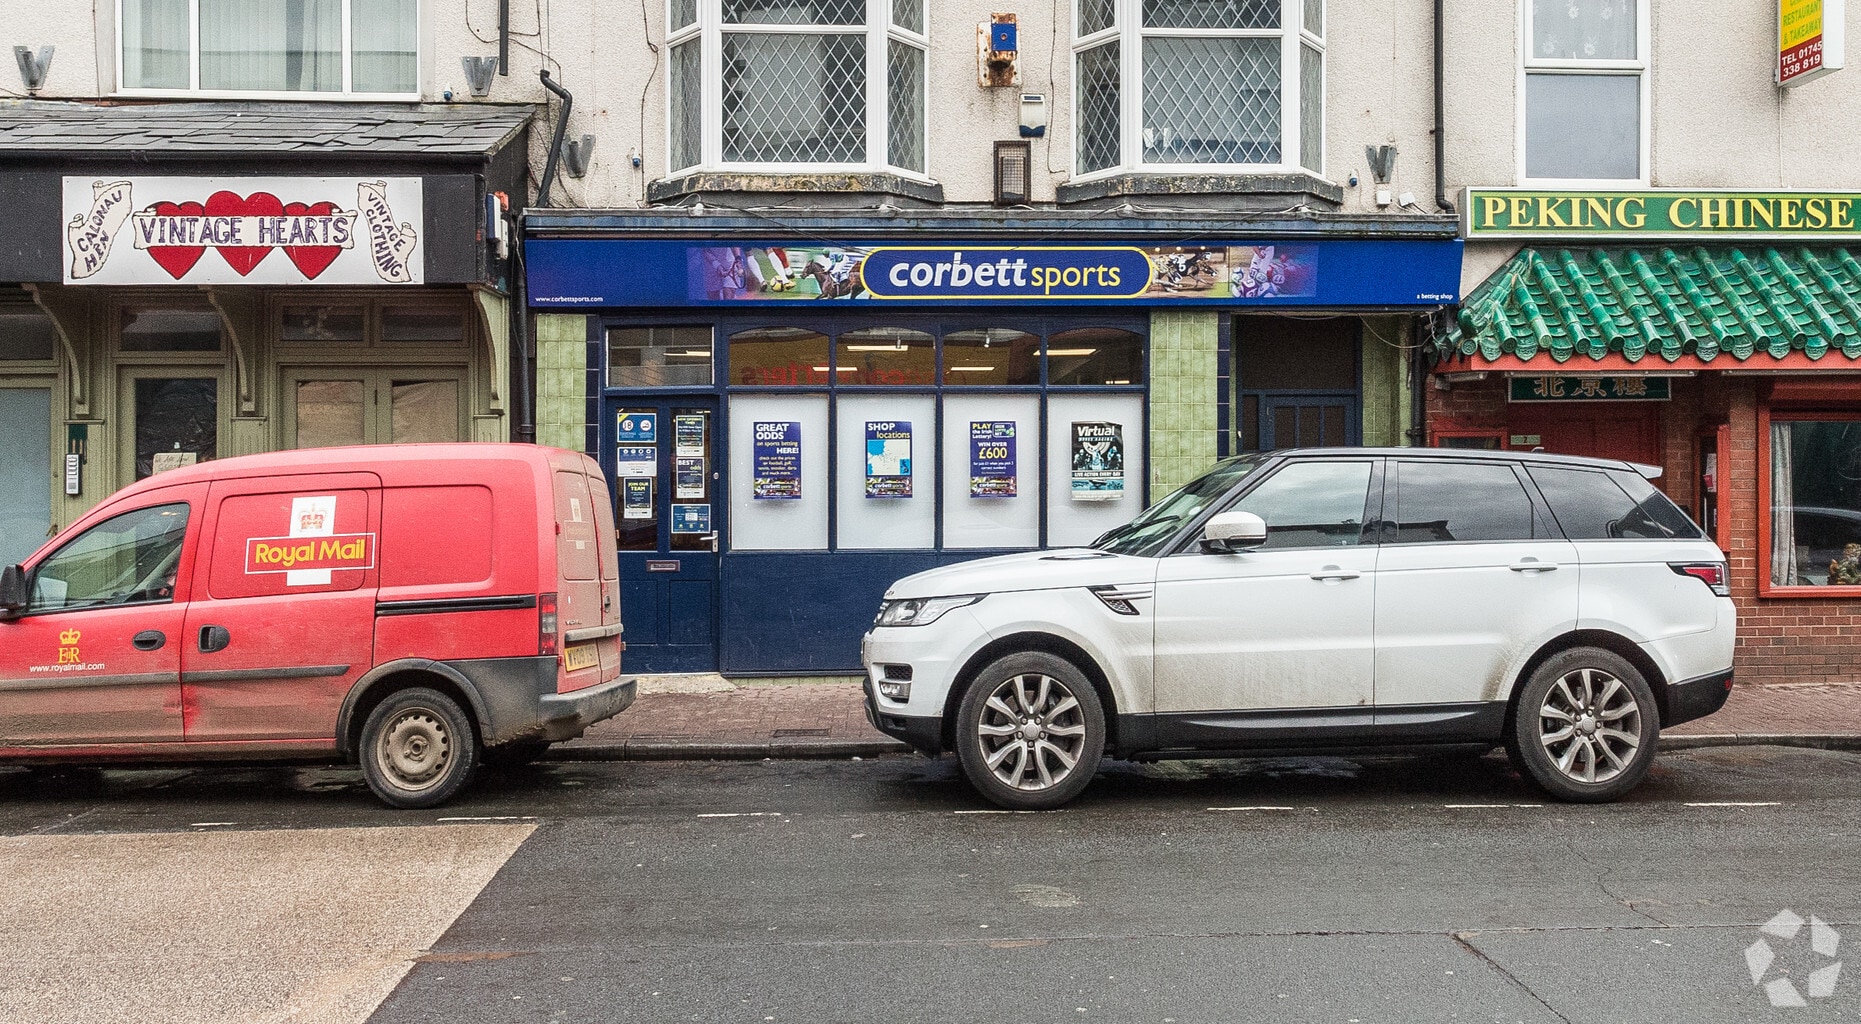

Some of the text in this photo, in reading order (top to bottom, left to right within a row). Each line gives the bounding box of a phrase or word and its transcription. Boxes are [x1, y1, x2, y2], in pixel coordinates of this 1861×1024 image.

[1784, 18, 1821, 45] & TAKEAWAY
[1782, 41, 1822, 66] TEL 01745
[1783, 54, 1820, 77] 338 819
[77, 190, 122, 253] CALONAU
[368, 192, 406, 252] VINTAGE
[1481, 197, 1855, 228] PEKING CHINESE
[140, 218, 349, 244] VINTAGE HEARTS
[366, 208, 402, 277] CLOTHING
[84, 230, 110, 272] HEN
[889, 252, 1121, 295] corbett sports
[1078, 426, 1115, 436] Virtual
[979, 448, 1007, 458] £600
[255, 539, 365, 567] Royal Mail
[30, 663, 105, 673] www.royalmail.com
